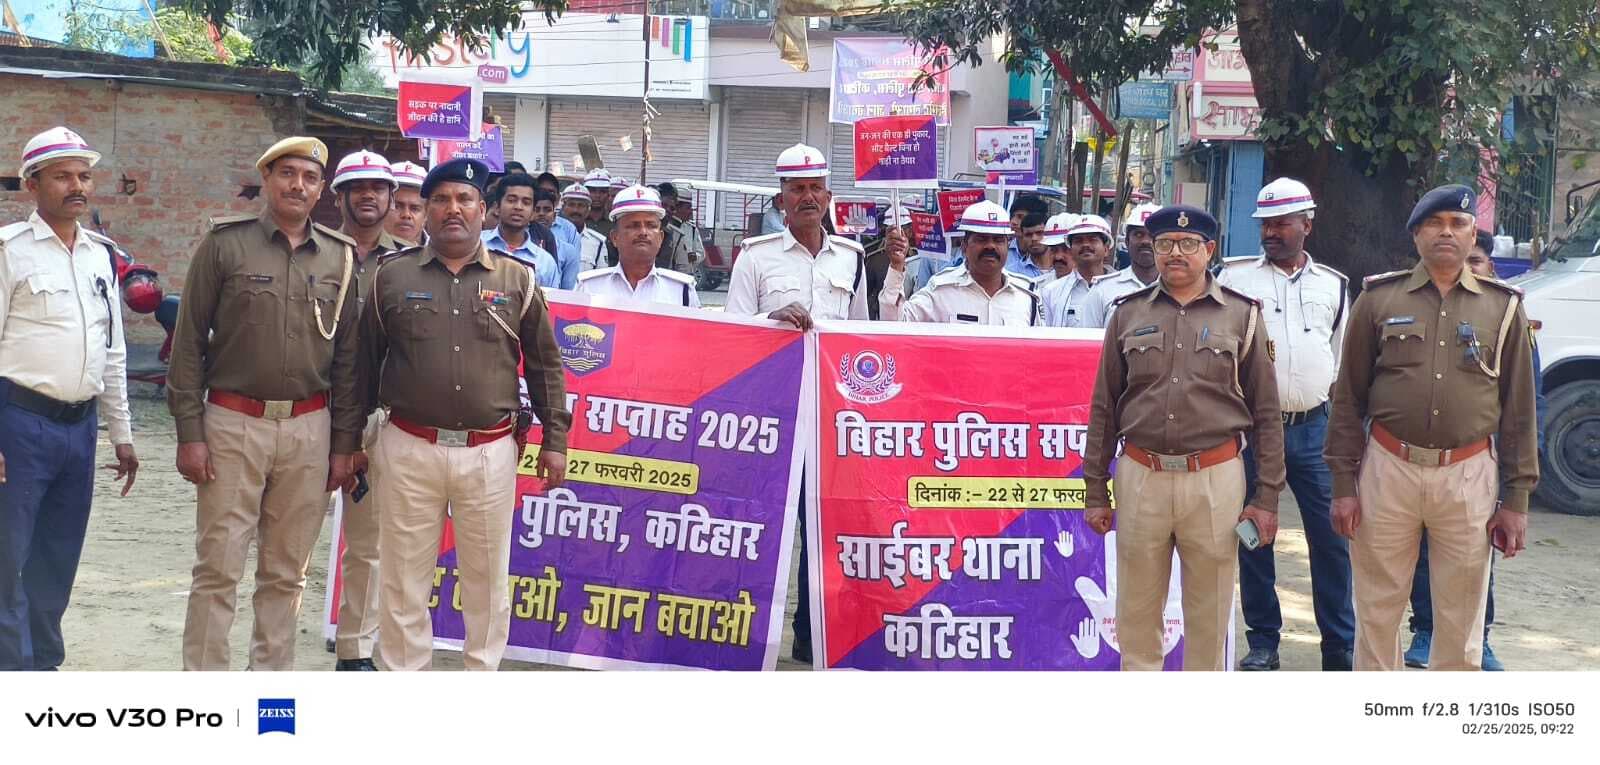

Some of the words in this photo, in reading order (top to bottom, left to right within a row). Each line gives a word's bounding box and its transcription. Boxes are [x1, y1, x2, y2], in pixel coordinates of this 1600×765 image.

[479, 66, 505, 80] .com
[408, 100, 427, 109] सड़क
[429, 102, 437, 110] पर
[439, 101, 461, 111] नादानी
[408, 112, 426, 121] जीवन
[428, 112, 438, 122] की
[439, 112, 446, 123] है
[447, 114, 462, 124] हानि
[882, 129, 891, 139] की
[892, 131, 903, 139] एक
[904, 129, 911, 139] ही
[804, 156, 811, 165] P
[636, 189, 645, 198] P
[583, 349, 606, 359] पुलिस
[585, 393, 694, 442] सप्ताह
[697, 410, 780, 455] 2025
[834, 409, 926, 458] बिहार
[931, 411, 1031, 472] पुलिस
[569, 460, 590, 476] 27
[594, 460, 646, 483] फरवरी
[649, 466, 692, 488] 2025
[914, 483, 962, 503] दिनांक
[987, 488, 1008, 502] 22
[1012, 484, 1025, 503] से
[1030, 488, 1047, 502] 27
[1053, 488, 1086, 504] फरव
[518, 487, 631, 553] पुलिस,
[645, 503, 765, 561] कटिहार
[836, 521, 955, 589] साईबर
[962, 536, 1044, 580] थाना
[582, 583, 650, 633] जान
[656, 590, 757, 648] बचाओ
[883, 603, 1014, 660] कटिहार
